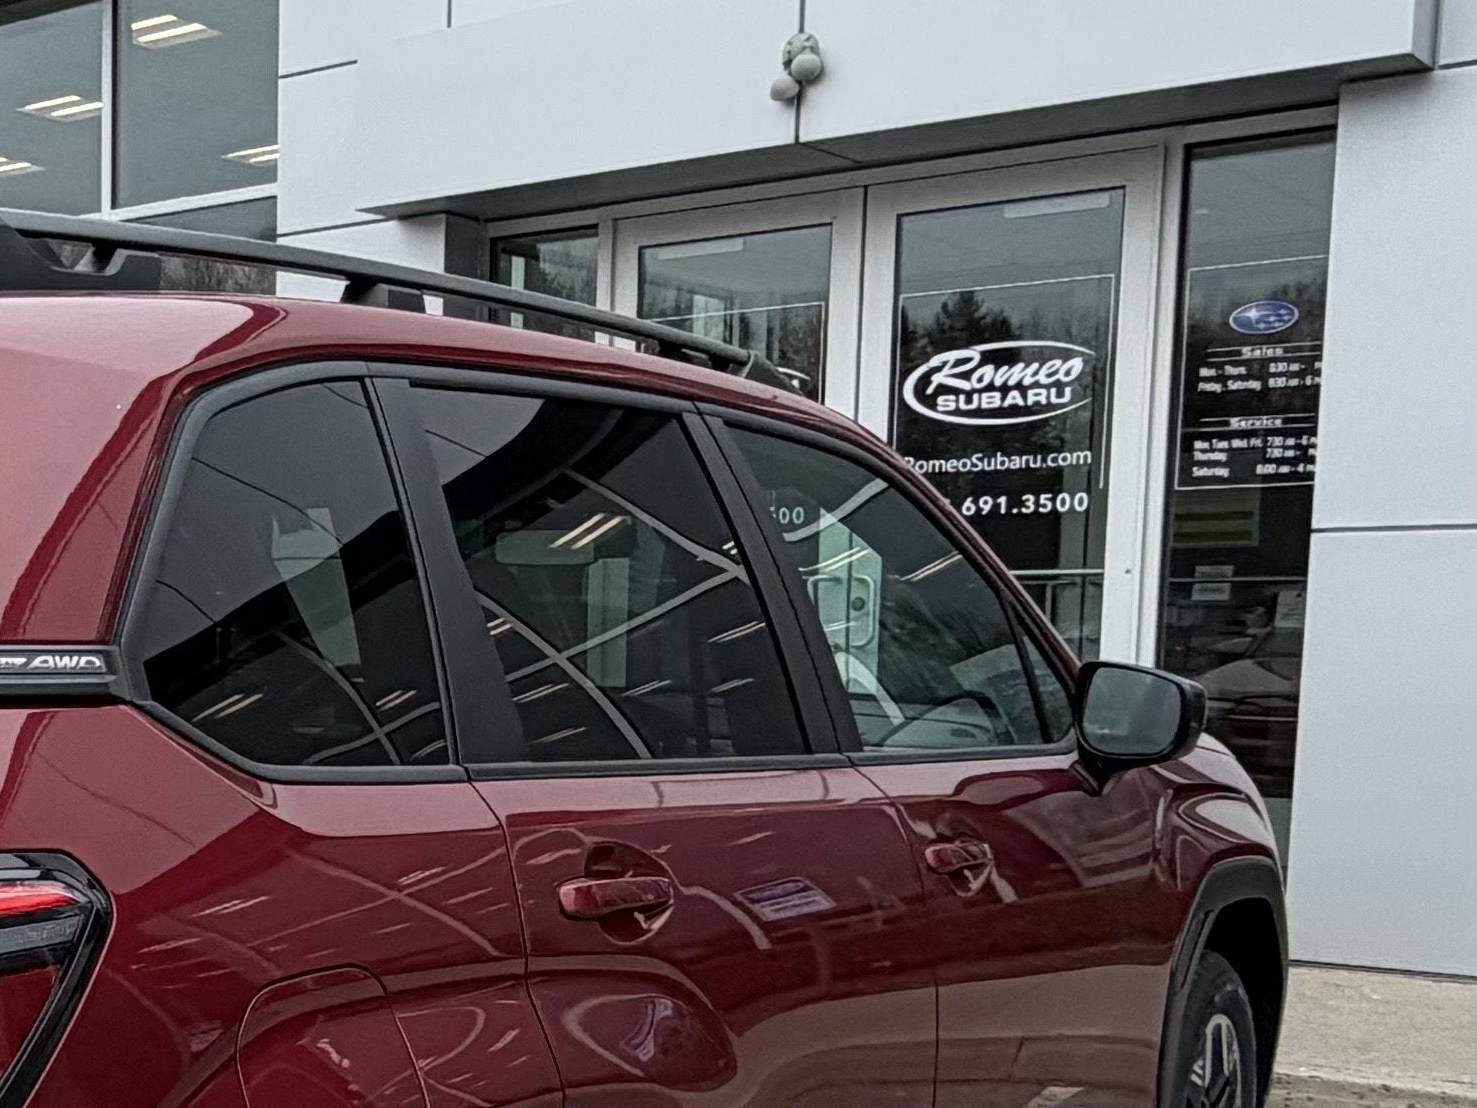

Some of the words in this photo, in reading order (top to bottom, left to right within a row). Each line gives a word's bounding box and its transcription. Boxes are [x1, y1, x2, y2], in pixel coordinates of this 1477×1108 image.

[925, 350, 1084, 395] Romeo
[936, 387, 1073, 411] SUBARU
[1230, 417, 1283, 428] Service
[961, 492, 1089, 515] 691.3500
[27, 655, 103, 670] AWD
